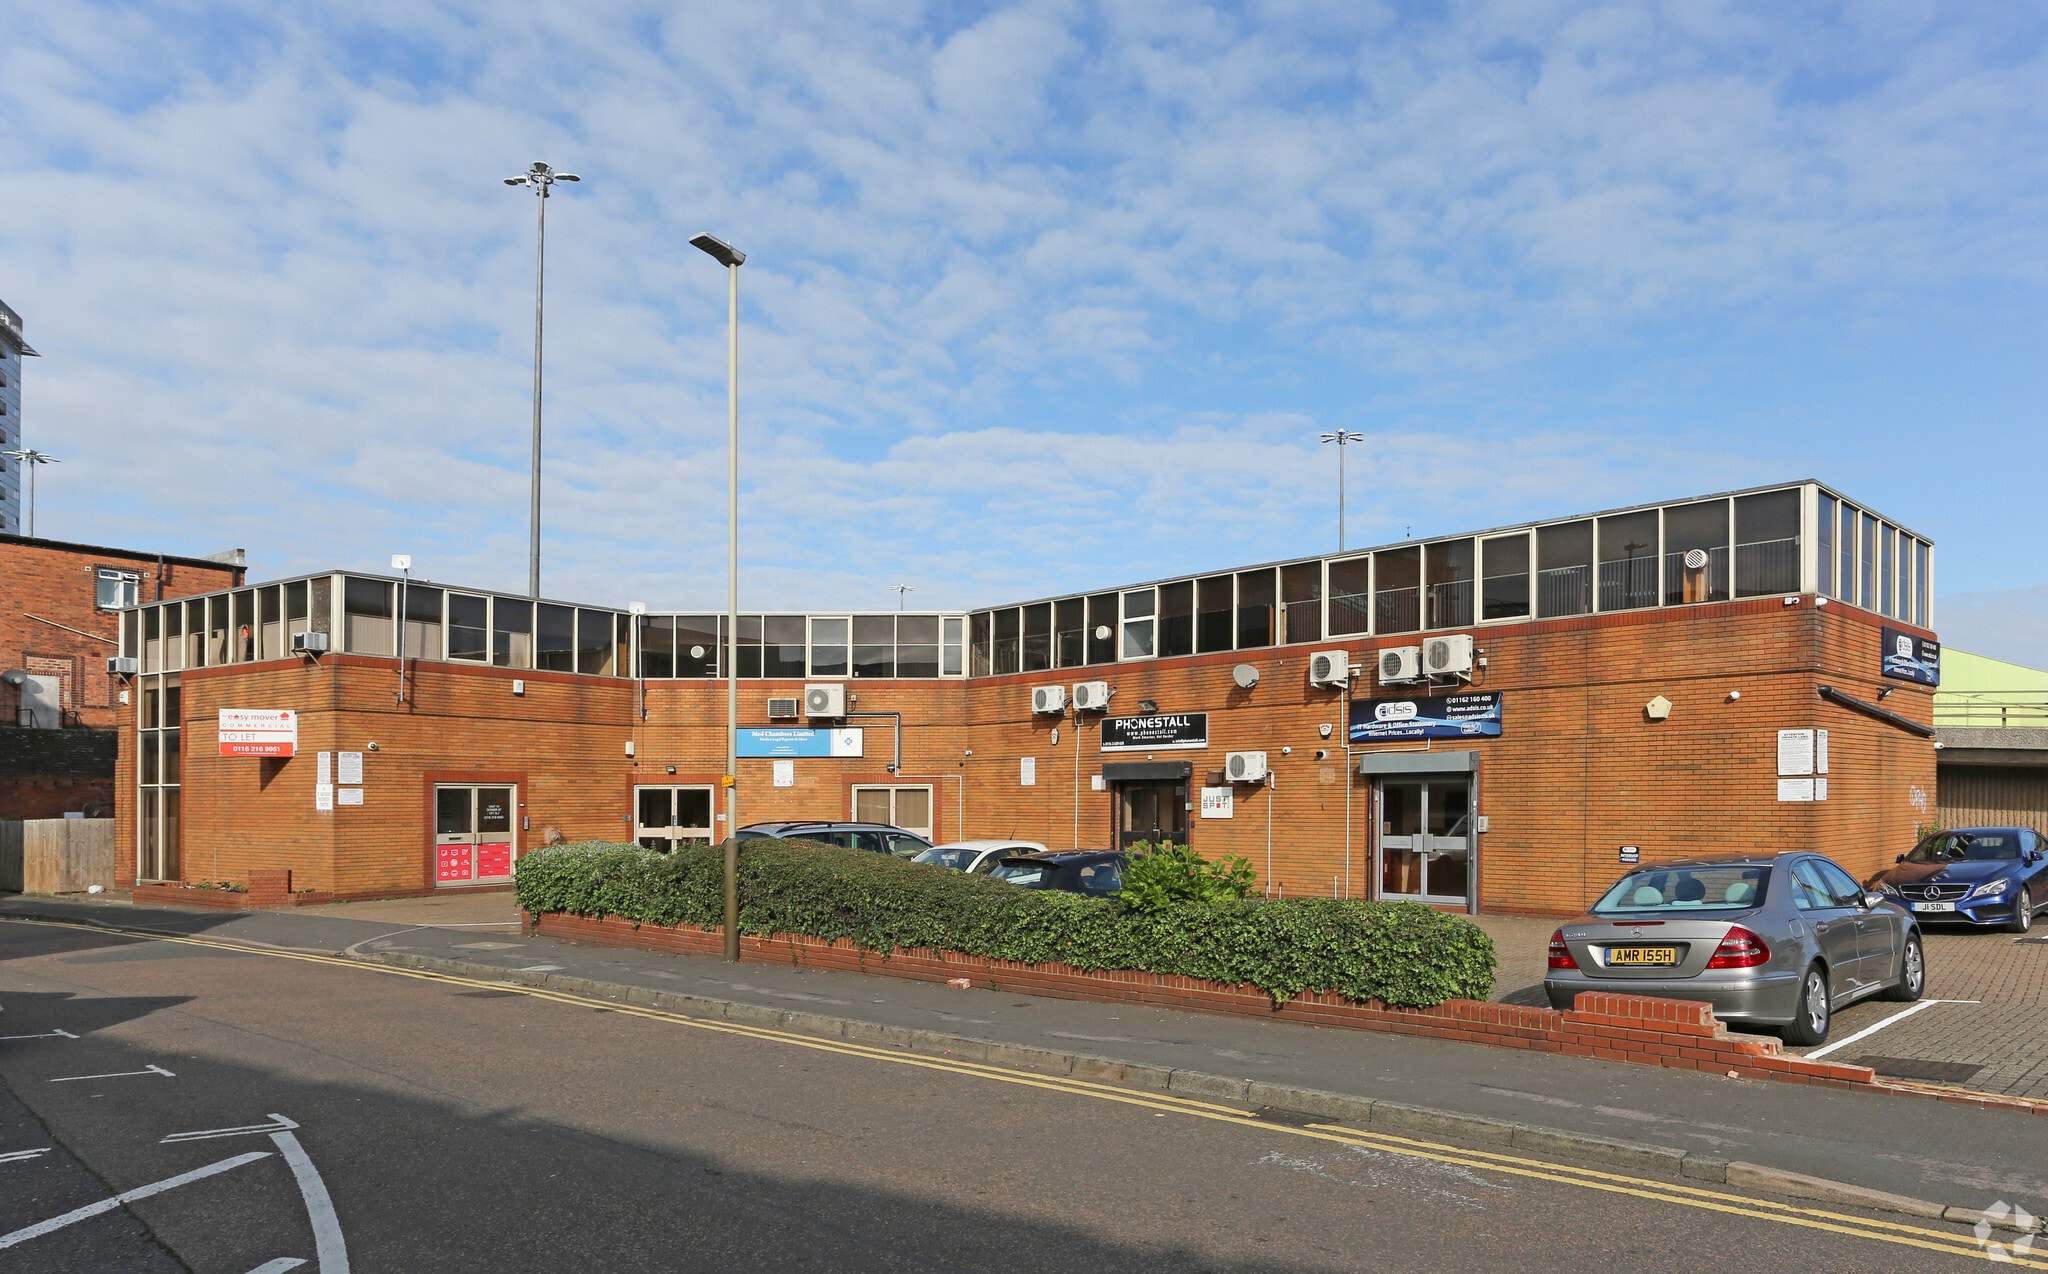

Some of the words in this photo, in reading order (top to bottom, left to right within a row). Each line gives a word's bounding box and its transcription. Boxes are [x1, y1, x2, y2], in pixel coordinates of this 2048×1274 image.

[1379, 704, 1412, 716] adsis
[1115, 716, 1191, 729] PHONESTALL
[1408, 720, 1437, 728] Stationery
[222, 733, 237, 741] TO
[240, 733, 256, 741] LET
[1930, 903, 1946, 911] SDL
[1615, 949, 1640, 962] AMR
[1642, 949, 1672, 962] 155H
